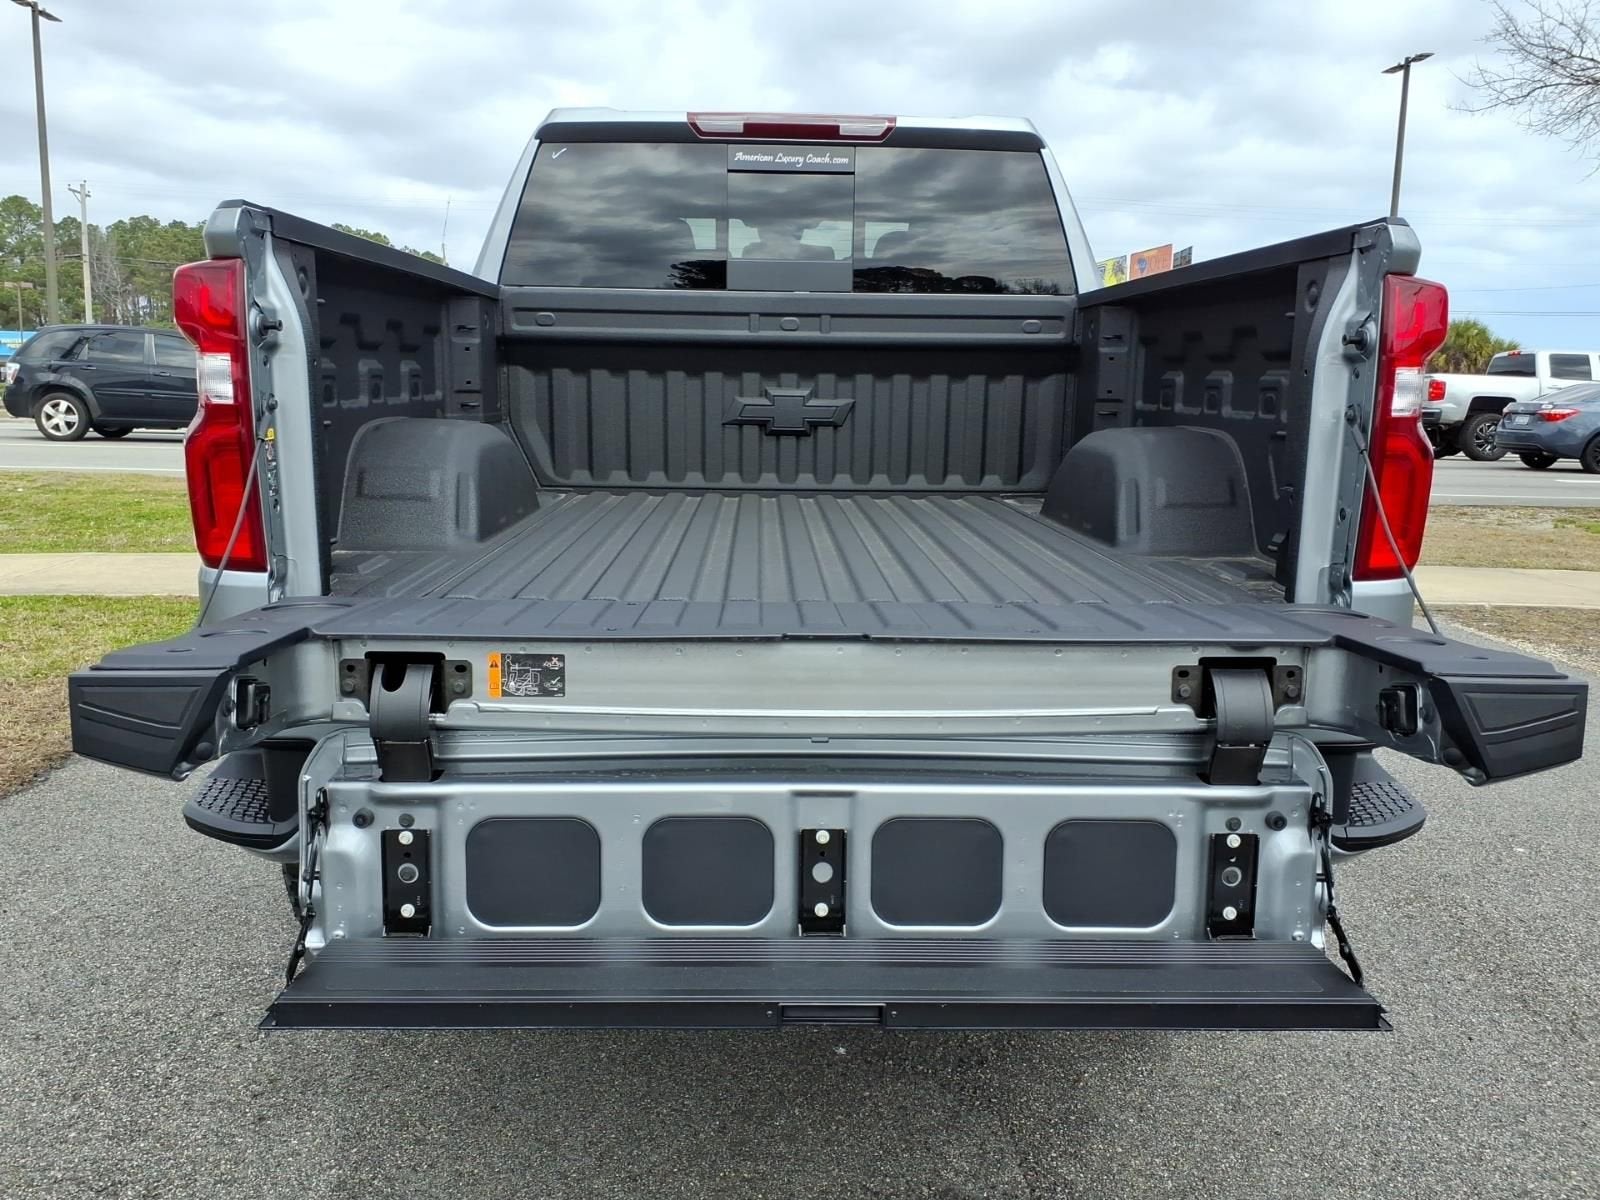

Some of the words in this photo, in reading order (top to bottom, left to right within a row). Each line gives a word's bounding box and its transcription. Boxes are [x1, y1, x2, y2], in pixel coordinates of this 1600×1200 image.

[734, 152, 773, 162] American
[775, 152, 804, 167] Luxury
[806, 153, 849, 164] Coach.com
